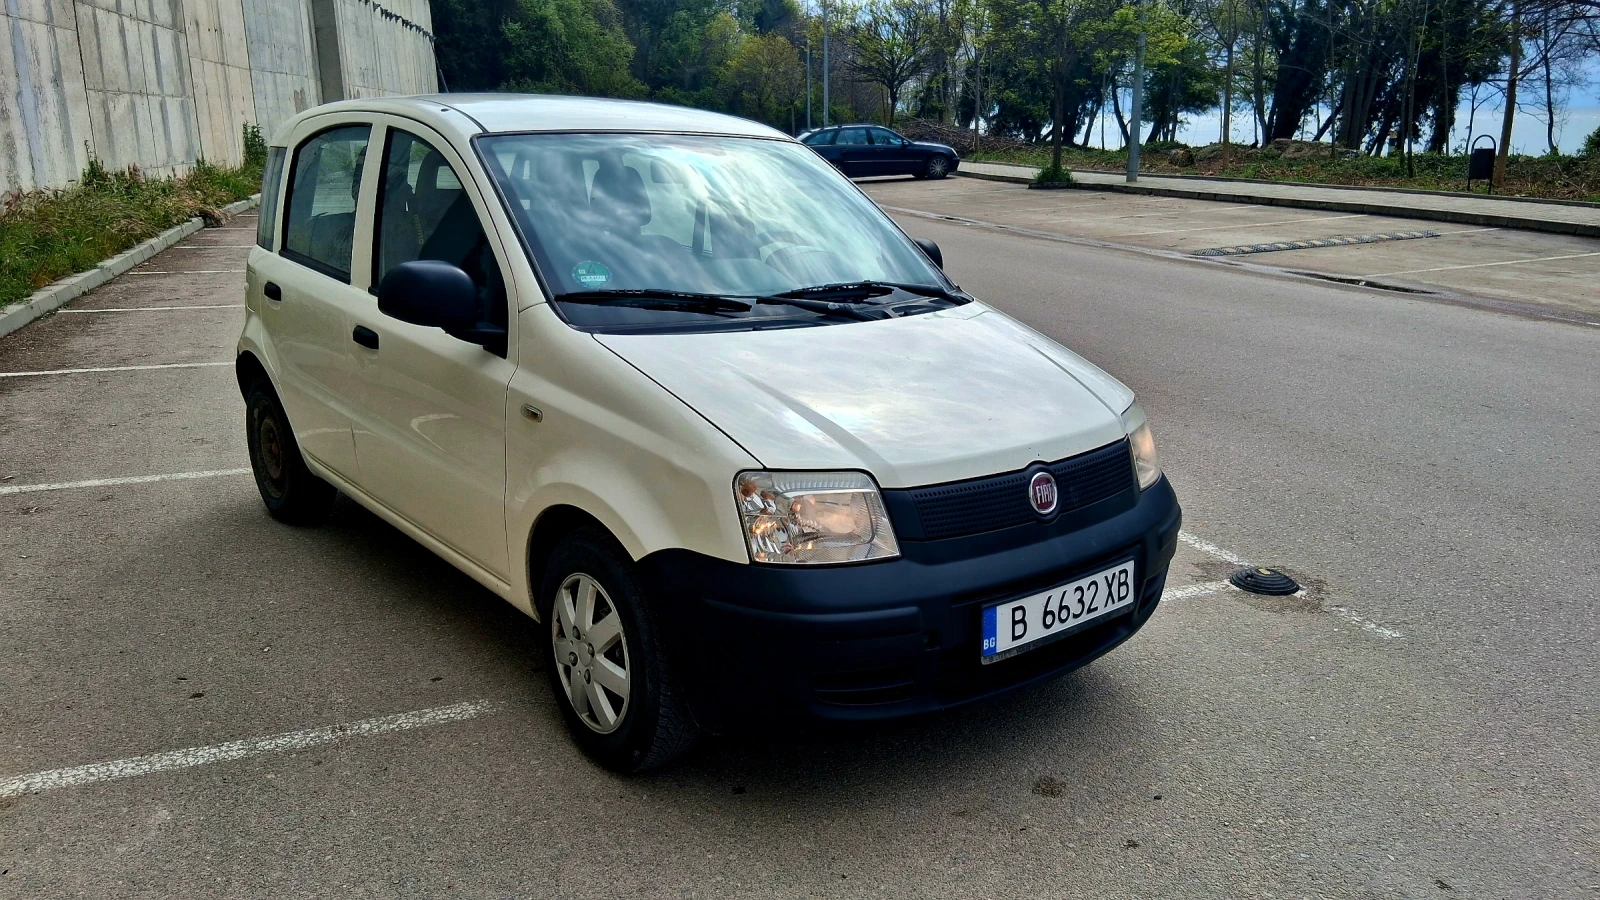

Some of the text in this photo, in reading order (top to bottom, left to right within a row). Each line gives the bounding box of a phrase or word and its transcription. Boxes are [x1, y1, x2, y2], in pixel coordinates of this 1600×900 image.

[1035, 483, 1053, 504] FIAT
[1011, 568, 1130, 642] B 6632 XB
[983, 637, 996, 650] BG
